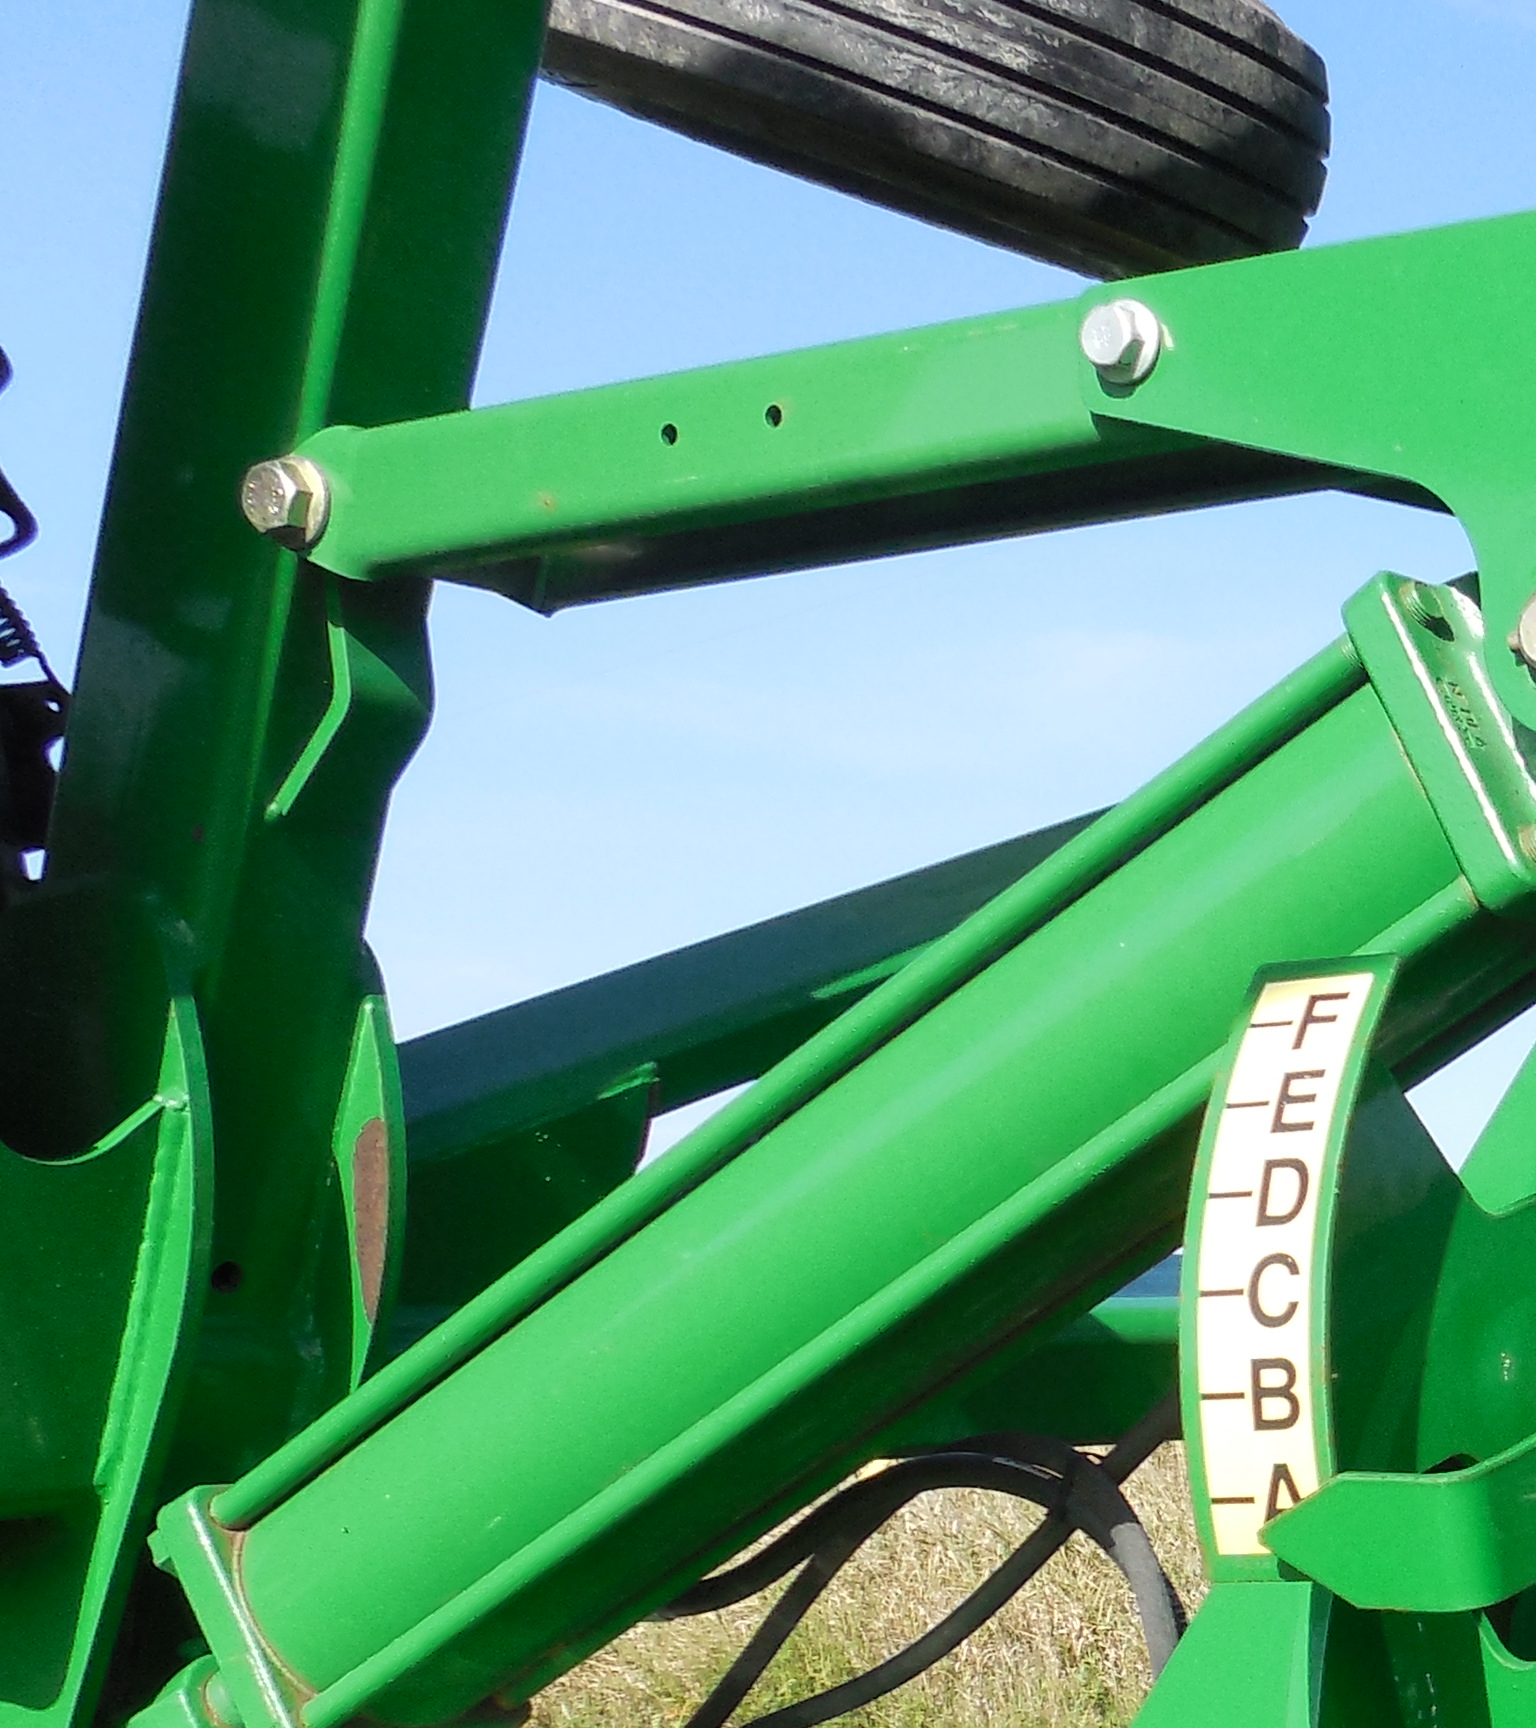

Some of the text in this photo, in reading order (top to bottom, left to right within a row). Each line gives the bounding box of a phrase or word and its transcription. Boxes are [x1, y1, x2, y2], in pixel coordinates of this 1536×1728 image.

[1292, 992, 1350, 1050] F
[1270, 1069, 1326, 1133] E
[1256, 1158, 1309, 1227] D
[1247, 1253, 1300, 1328] C
[1251, 1358, 1300, 1431] B
[1264, 1463, 1302, 1524] A
